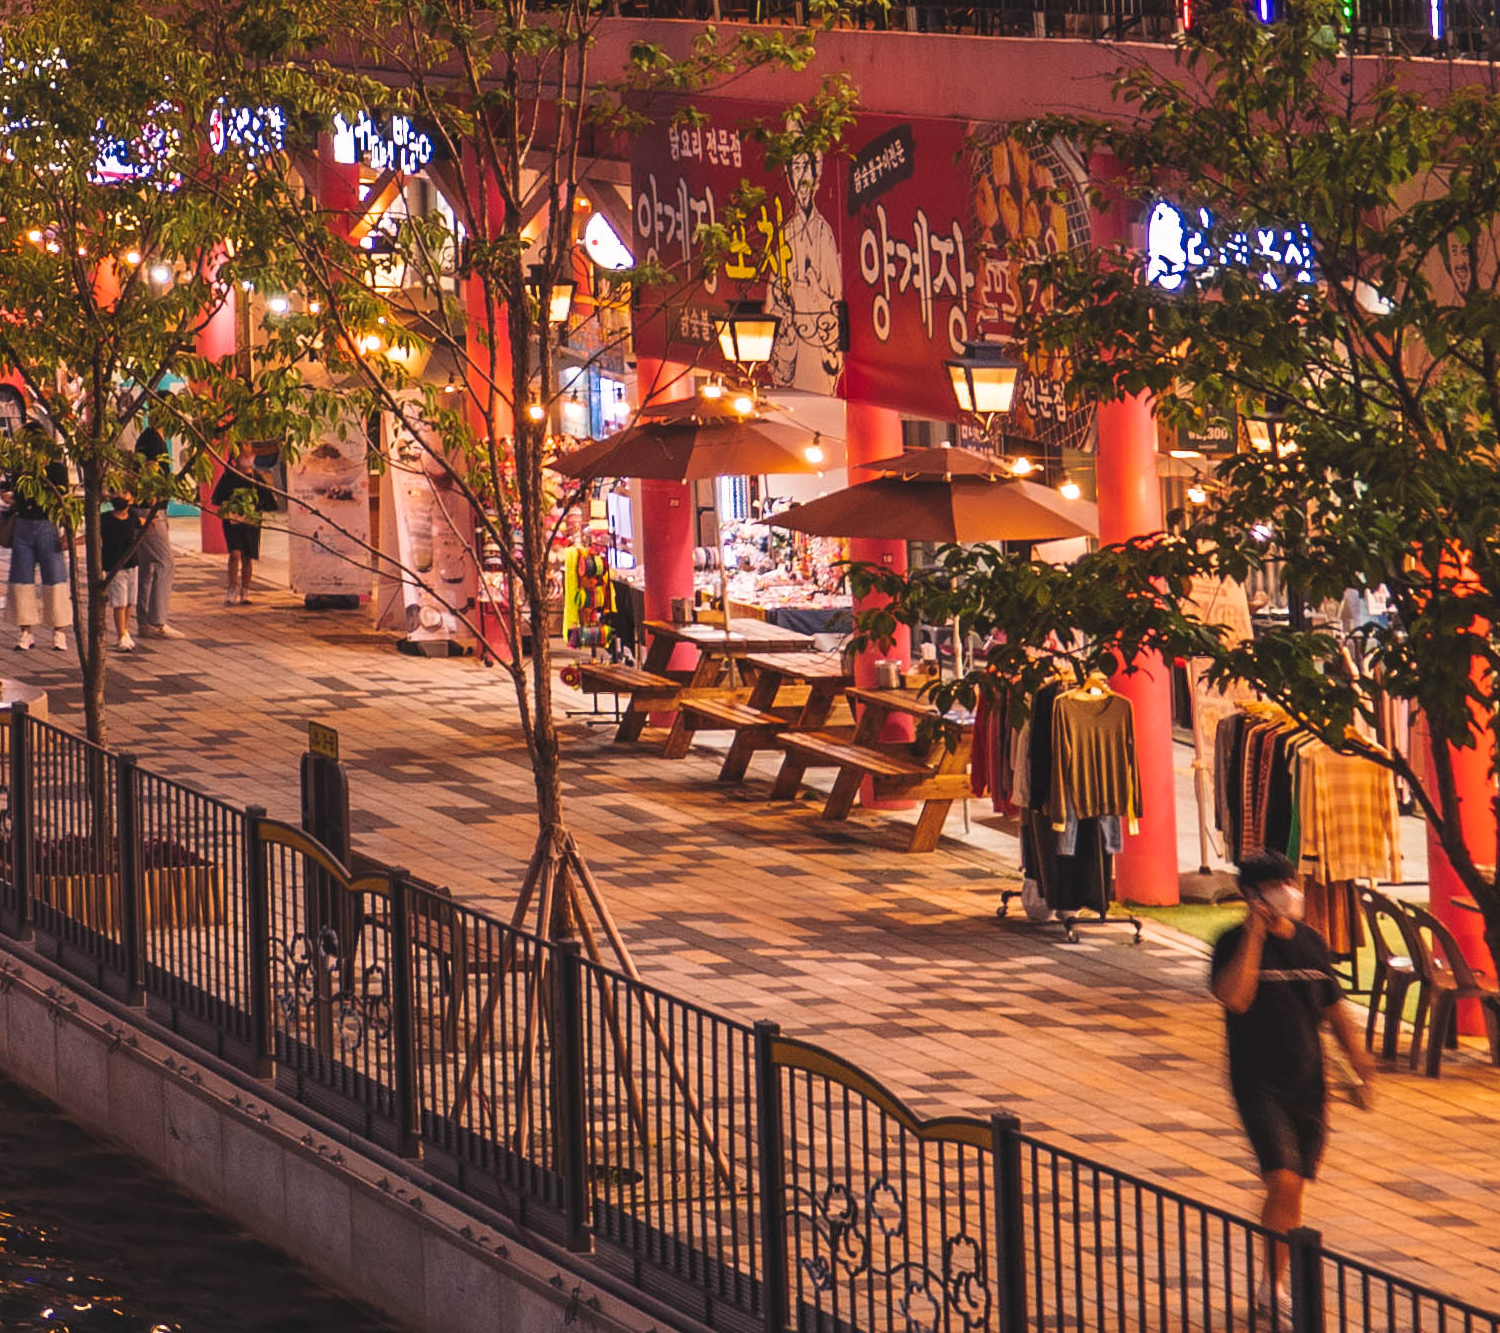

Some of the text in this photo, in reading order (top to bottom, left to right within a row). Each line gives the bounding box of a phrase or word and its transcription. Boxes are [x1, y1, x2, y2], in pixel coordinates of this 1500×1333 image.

[705, 126, 743, 169] 전문점
[637, 173, 717, 295] 양계장
[860, 203, 975, 356] 양계장
[1023, 375, 1067, 422] 전문점
